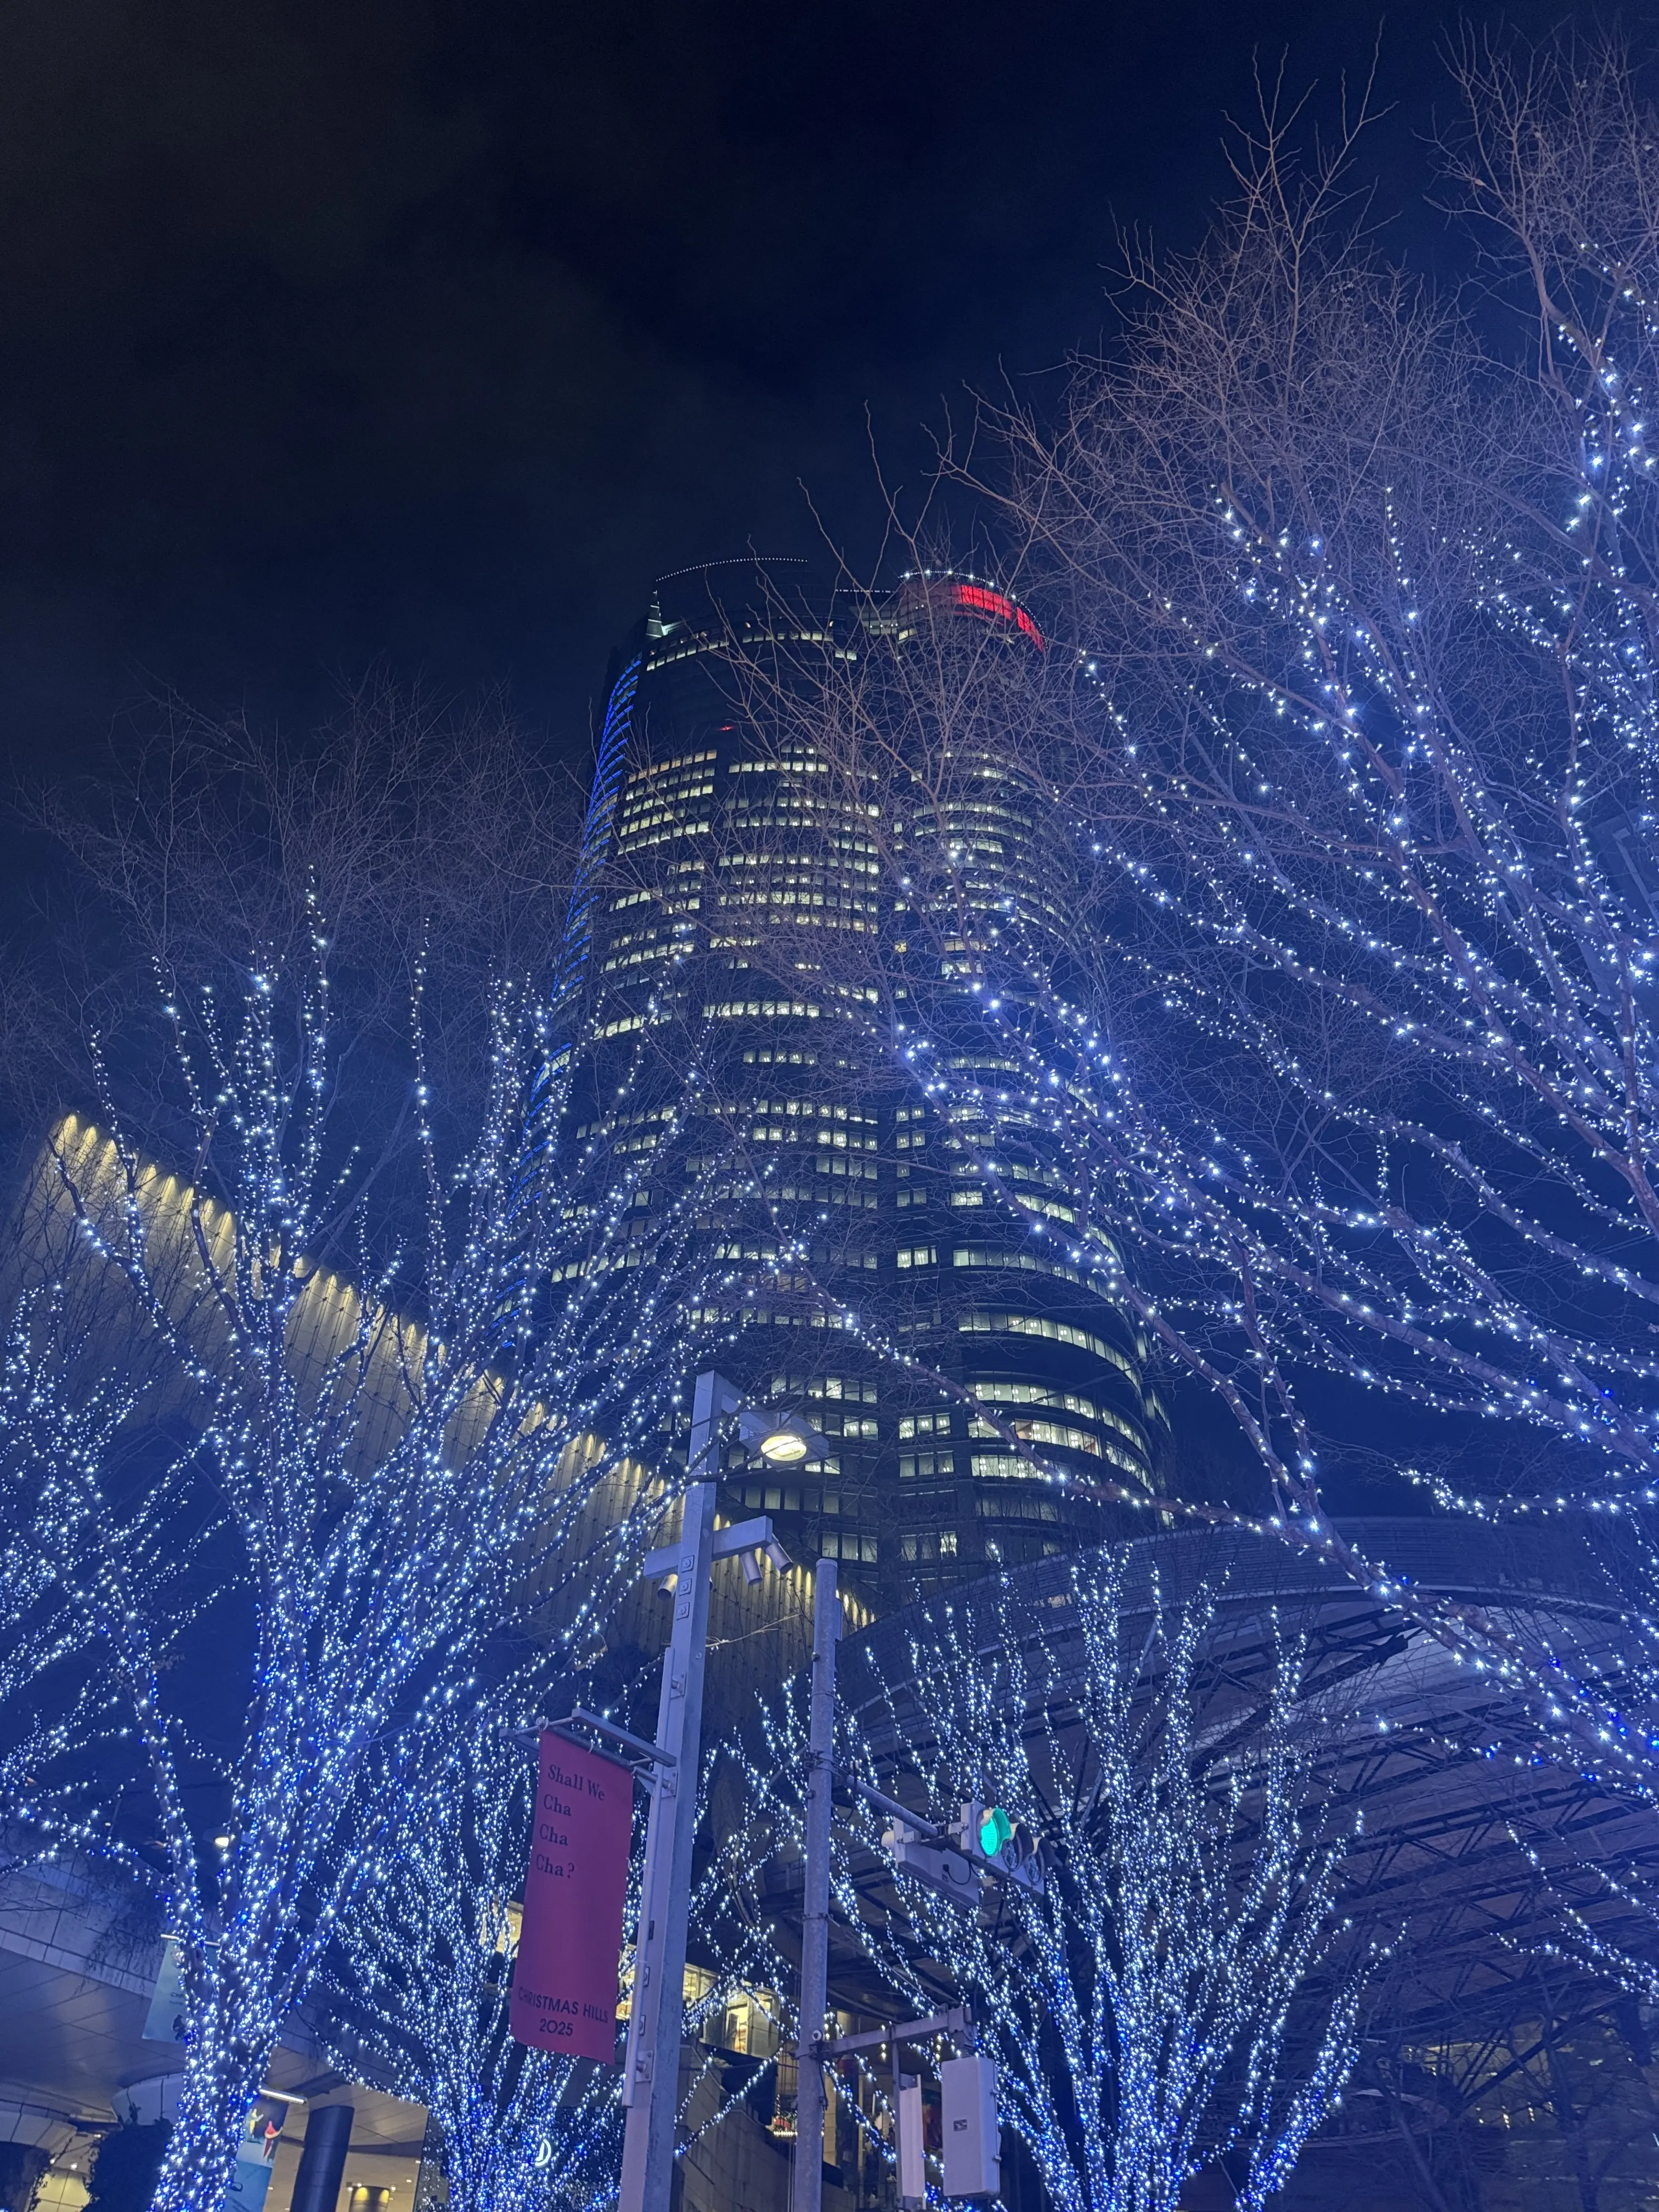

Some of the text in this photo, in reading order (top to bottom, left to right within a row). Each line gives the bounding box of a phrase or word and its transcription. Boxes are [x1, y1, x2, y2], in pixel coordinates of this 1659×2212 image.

[548, 1764, 605, 1801] Shall We
[543, 1793, 572, 1816] Cha
[540, 1823, 568, 1846] Cha
[518, 1986, 608, 2024] CHRISTMAS HILLS
[539, 2018, 574, 2036] 2025
